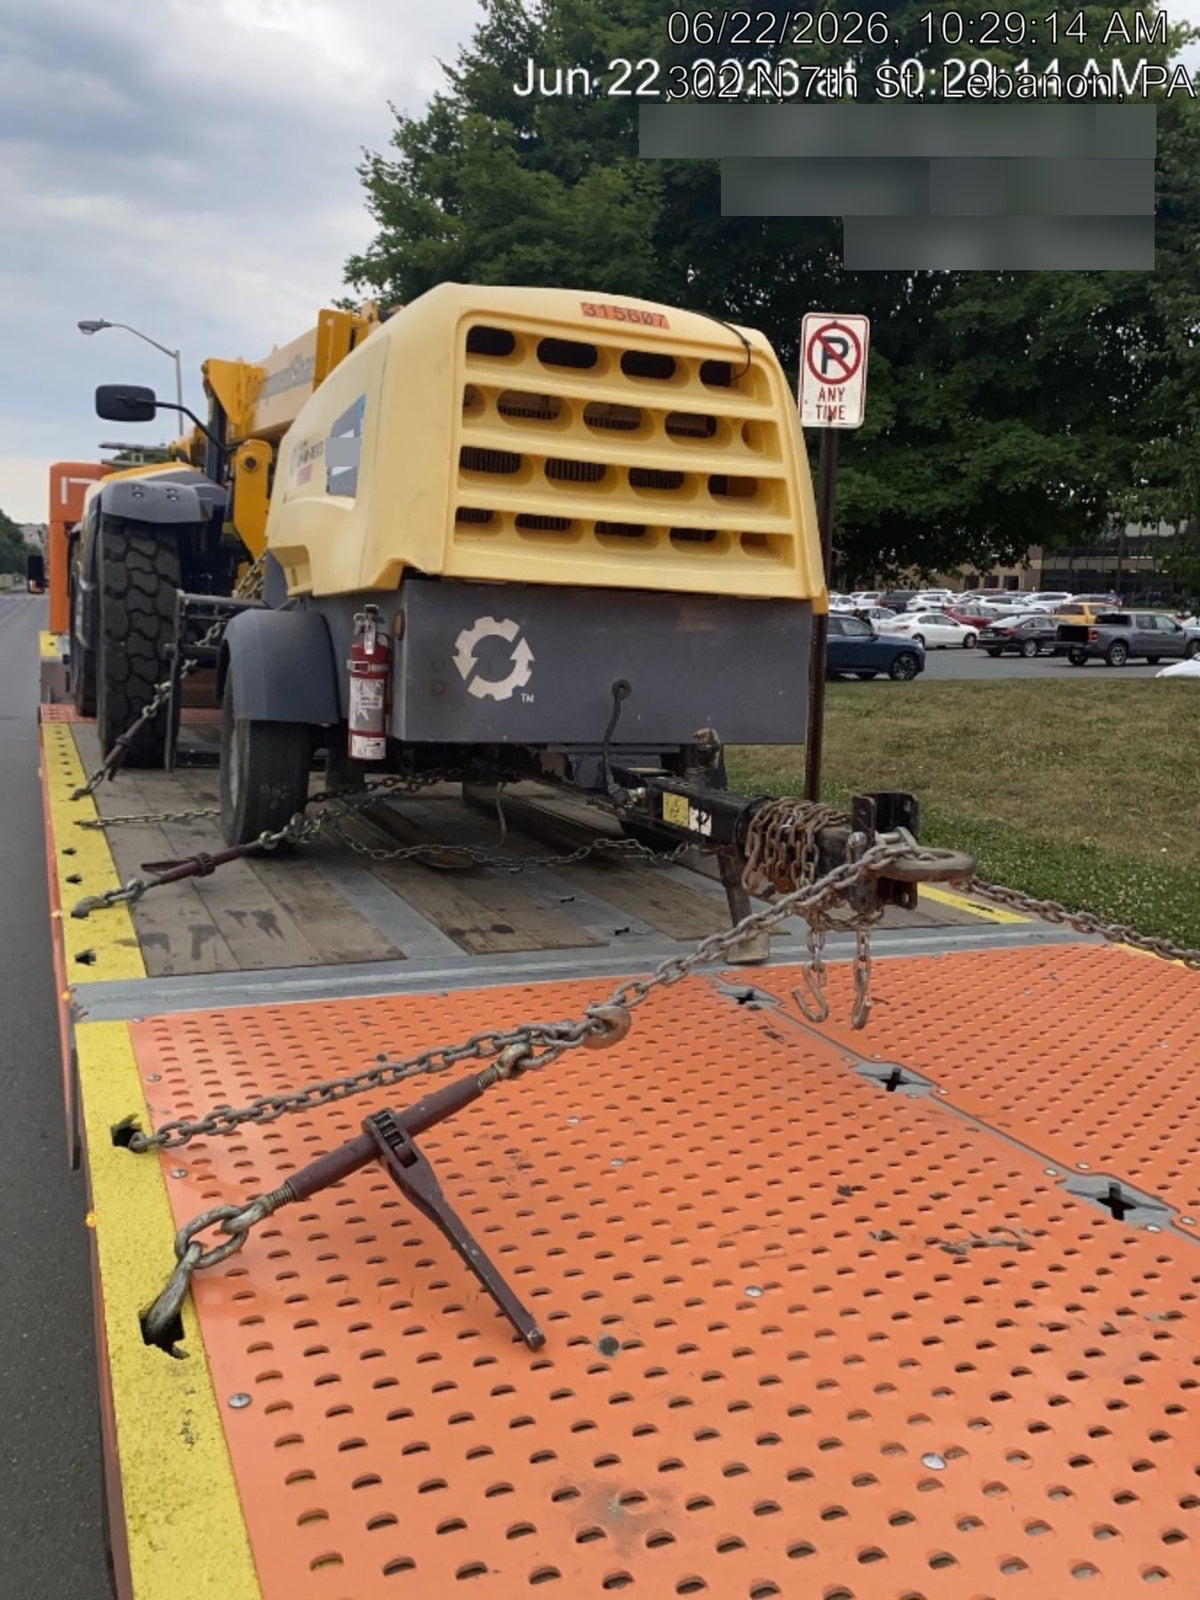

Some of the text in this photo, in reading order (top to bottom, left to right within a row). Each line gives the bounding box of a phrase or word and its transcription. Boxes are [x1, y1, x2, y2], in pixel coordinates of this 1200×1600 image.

[582, 303, 665, 327] 315607
[818, 386, 845, 402] ANY
[815, 404, 846, 421] TIME
